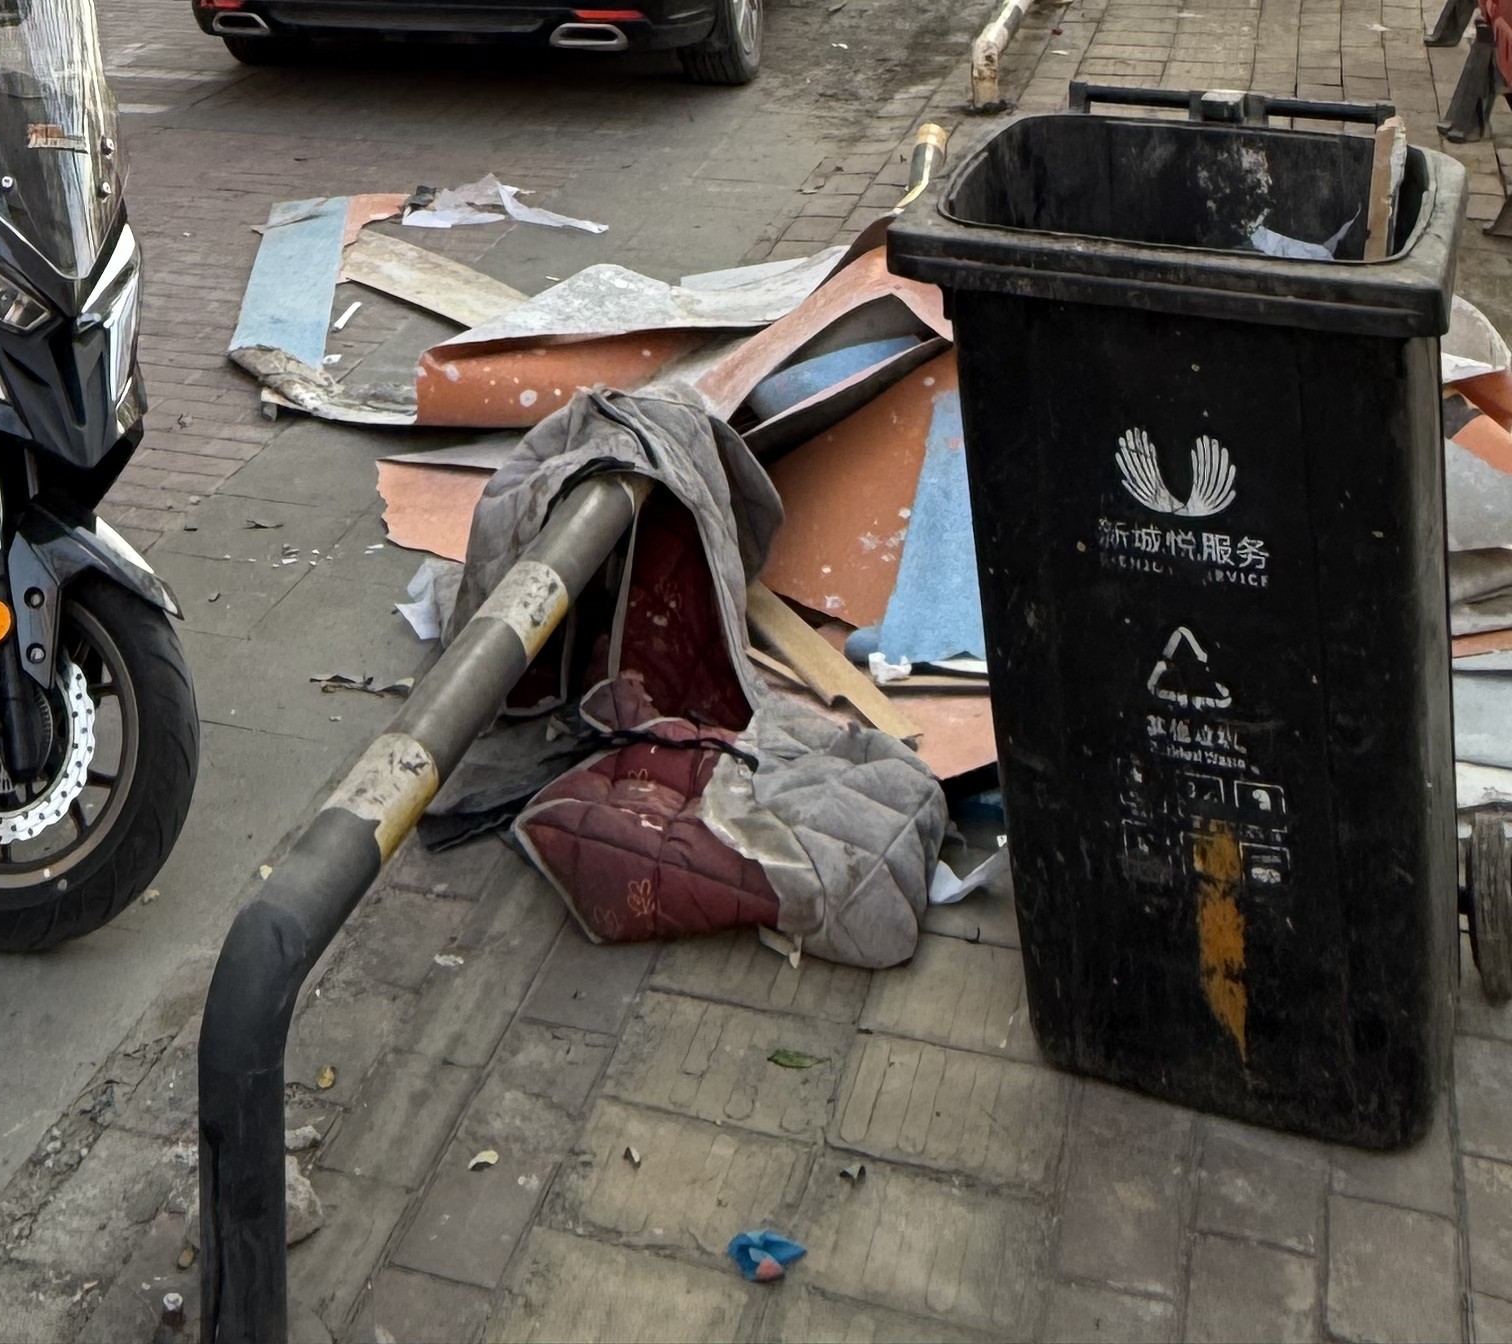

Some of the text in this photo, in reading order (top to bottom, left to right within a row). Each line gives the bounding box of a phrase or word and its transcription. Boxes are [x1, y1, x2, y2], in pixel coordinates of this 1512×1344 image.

[1098, 516, 1272, 570] 新城悦服务
